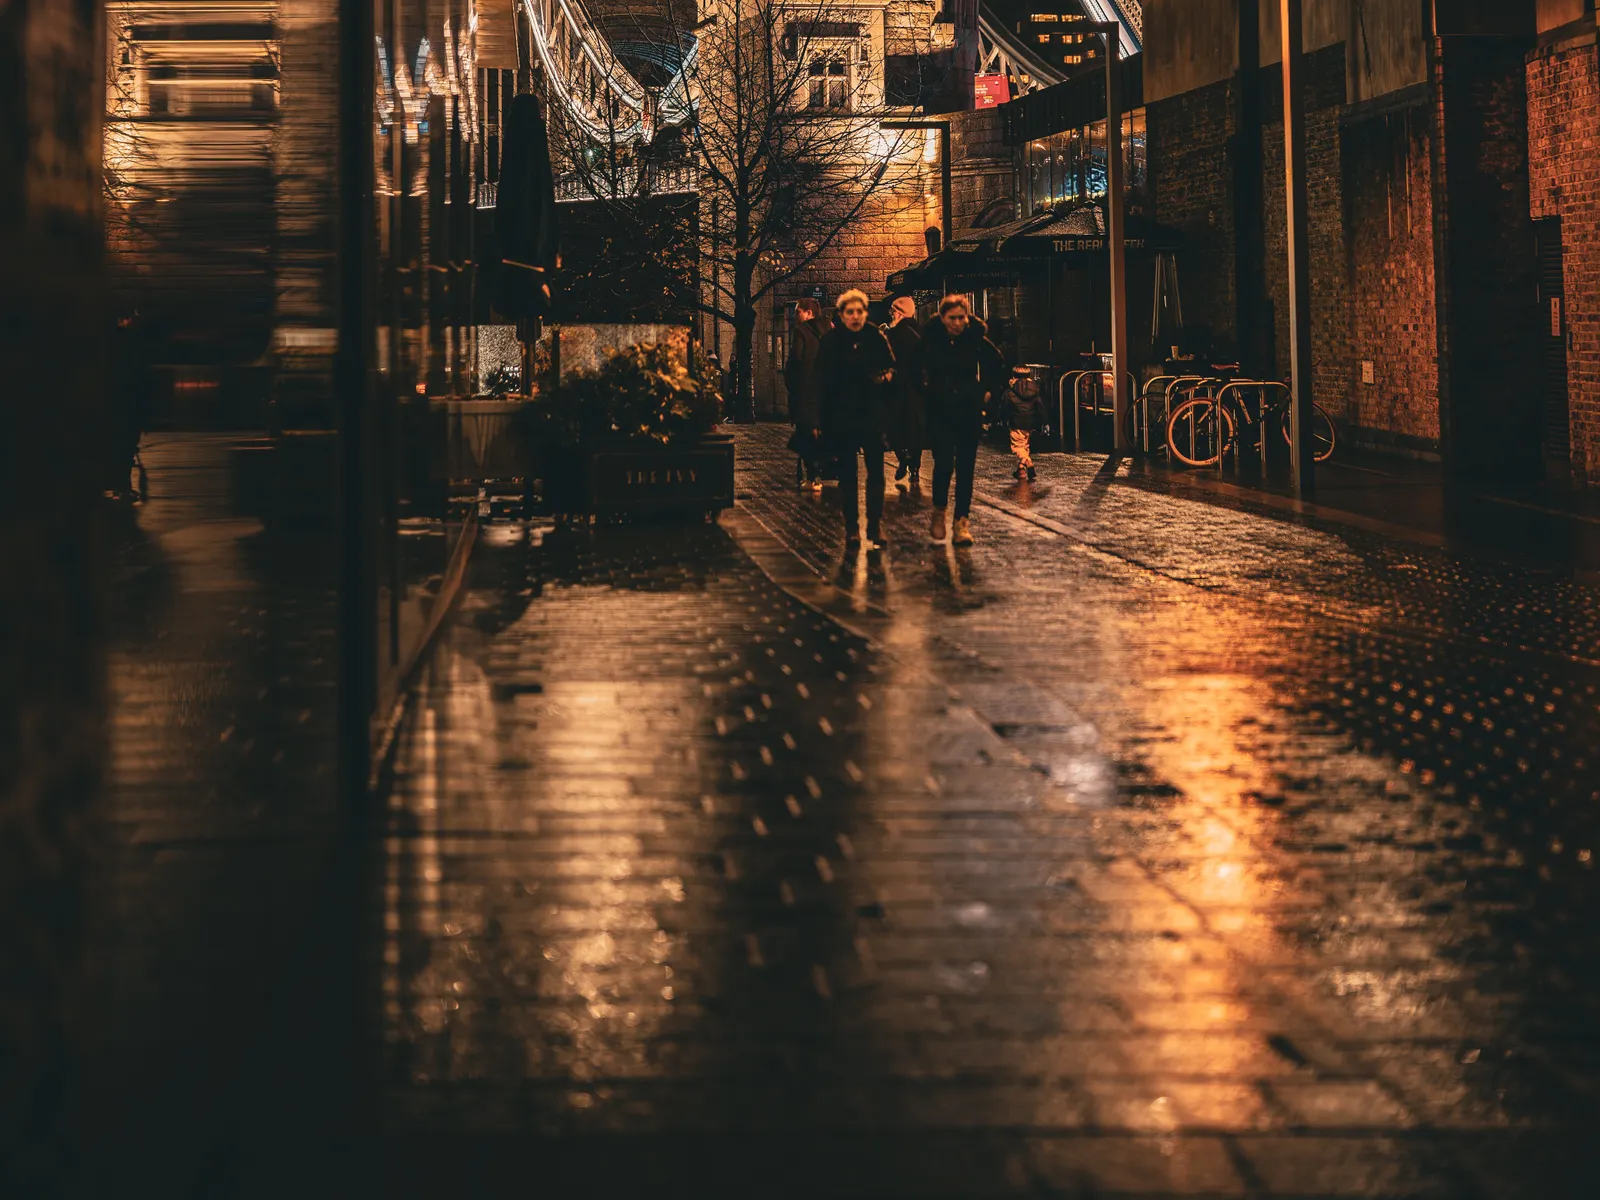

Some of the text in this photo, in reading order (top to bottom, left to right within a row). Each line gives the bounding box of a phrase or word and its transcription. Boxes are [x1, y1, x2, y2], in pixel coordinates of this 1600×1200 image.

[1052, 240, 1075, 252] THE
[626, 469, 698, 485] THE IVY
